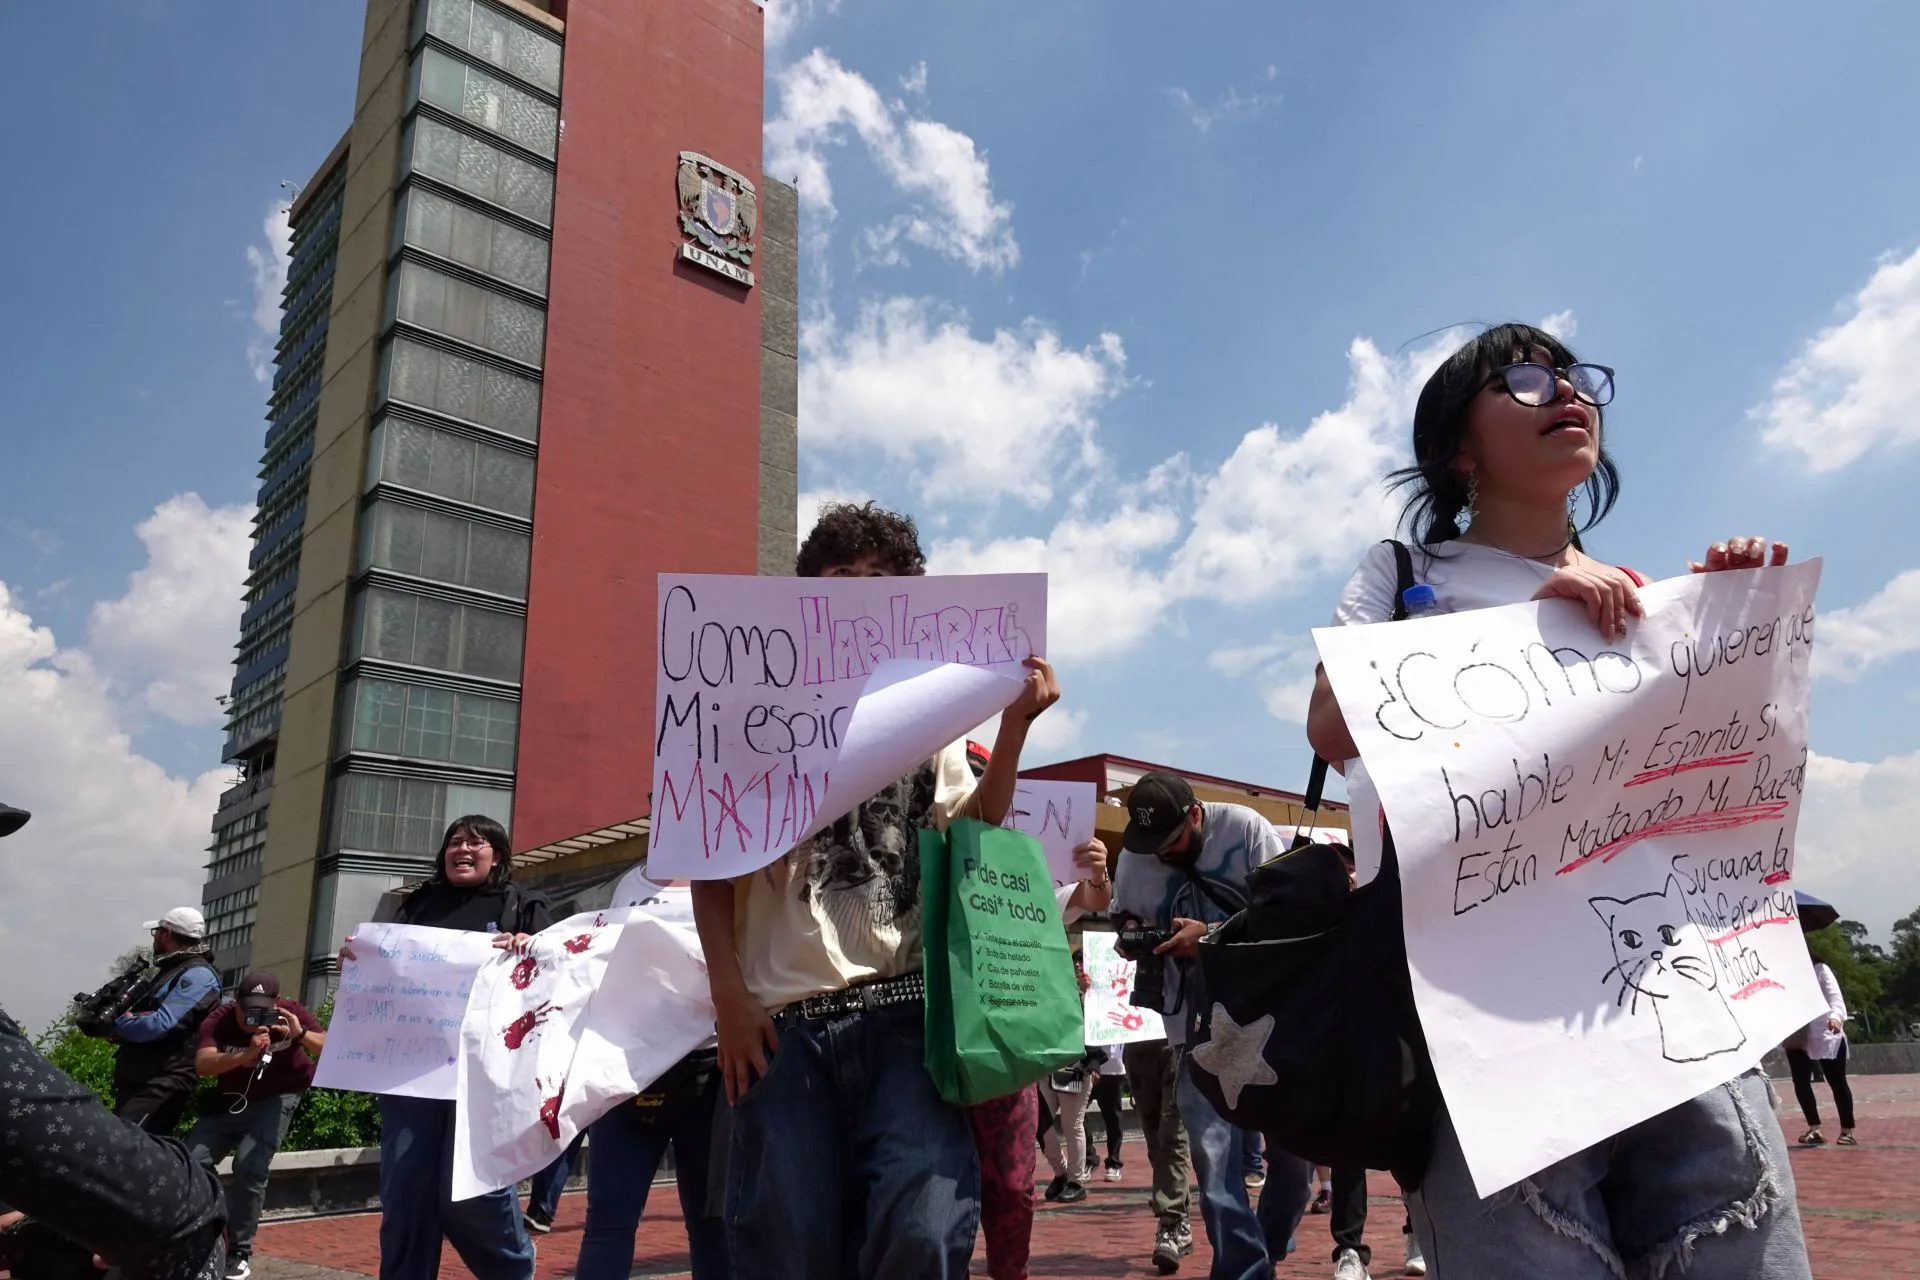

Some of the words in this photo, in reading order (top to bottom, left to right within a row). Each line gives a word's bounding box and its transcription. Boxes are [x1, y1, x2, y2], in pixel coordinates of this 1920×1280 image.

[688, 247, 750, 283] UNAM
[662, 585, 797, 687] Como
[1369, 635, 1642, 741] ¿Cómo
[1671, 617, 1782, 714] quieren
[1785, 604, 1814, 663] que
[656, 691, 721, 764] Mi
[1441, 753, 1575, 843] hable
[1592, 739, 1630, 785] Mi
[1559, 787, 1683, 863] Matando
[1695, 776, 1730, 816] Mi
[1745, 746, 1808, 808] Raza?
[1772, 827, 1789, 876] la
[963, 857, 998, 887] Pide
[1000, 872, 1031, 894] casi
[1007, 898, 1047, 924] todo
[1000, 950, 1007, 960] de
[1008, 952, 1031, 962] helado
[1019, 940, 1042, 949] cabello
[1714, 935, 1769, 988] Mata
[1000, 966, 1010, 975] de
[1010, 967, 1041, 978] pañuelos
[1011, 982, 1020, 991] de
[1021, 984, 1035, 992] vino
